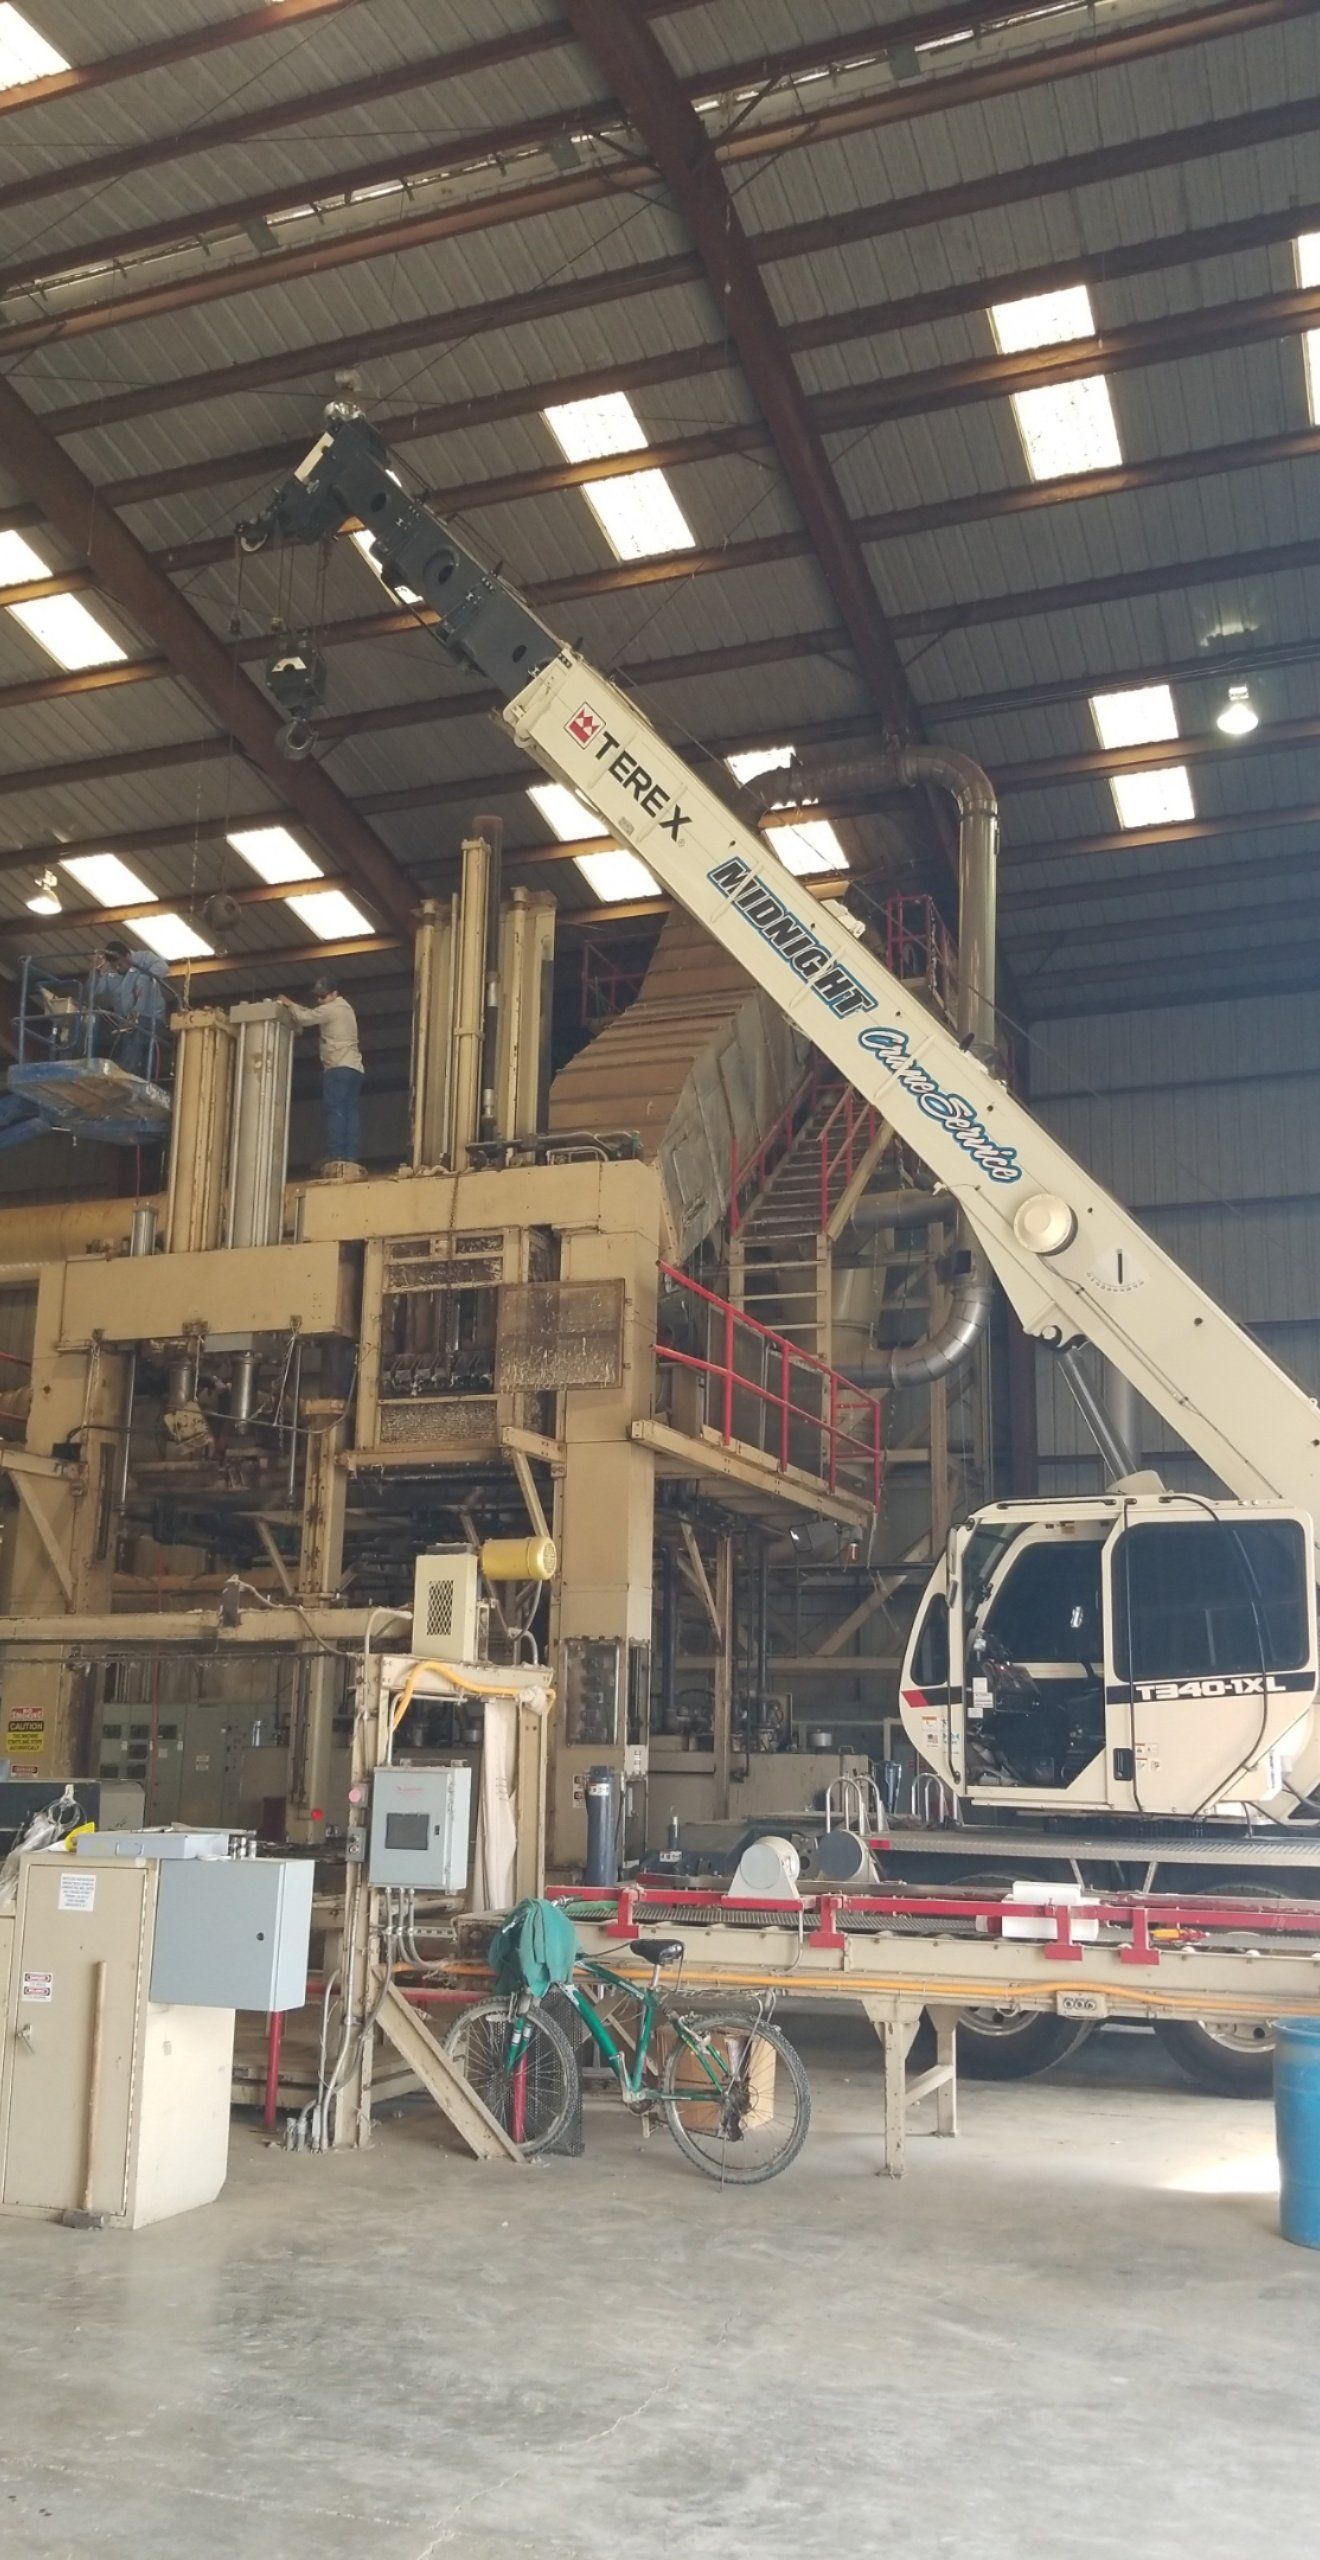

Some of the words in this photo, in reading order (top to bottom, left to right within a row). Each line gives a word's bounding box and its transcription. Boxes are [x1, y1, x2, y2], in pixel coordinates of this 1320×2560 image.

[595, 731, 692, 842] TEREX
[708, 857, 878, 1018] MIDNIGHT
[858, 1027, 938, 1096] Crane
[917, 1093, 1022, 1183] Service
[9, 1722, 43, 1731] CAUTION
[1136, 1677, 1286, 1700] T340-1XL
